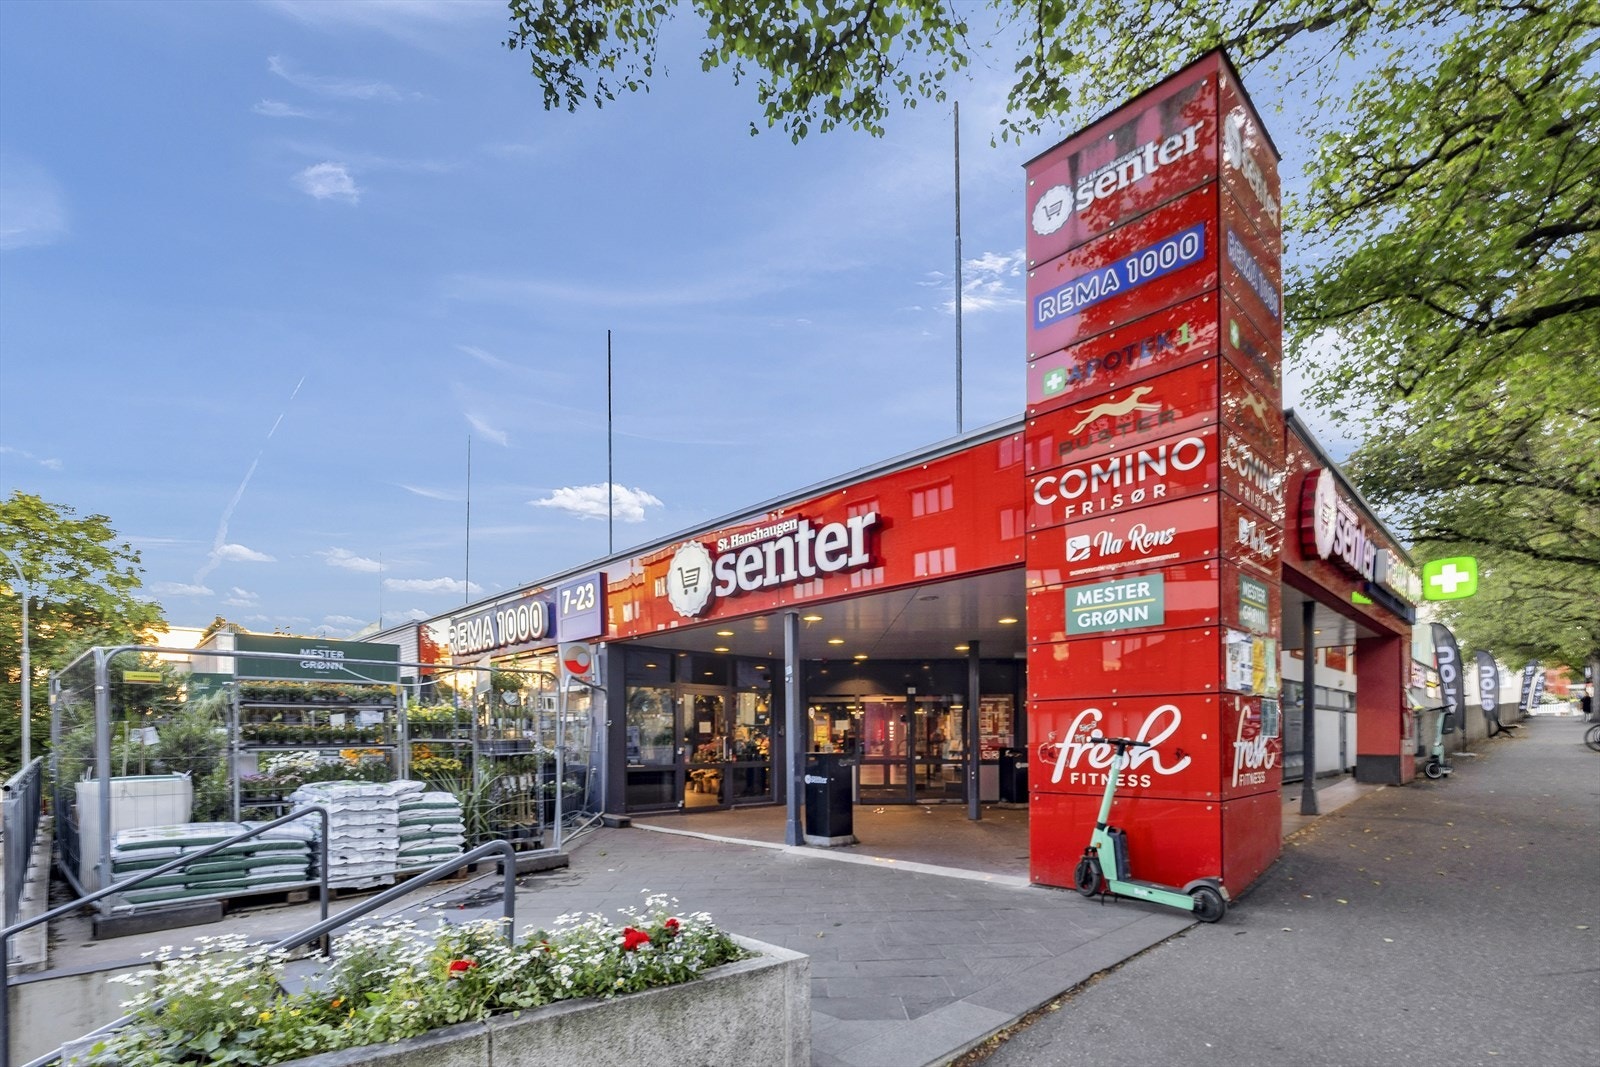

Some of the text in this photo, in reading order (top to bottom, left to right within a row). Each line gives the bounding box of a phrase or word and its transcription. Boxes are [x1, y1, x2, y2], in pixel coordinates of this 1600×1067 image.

[1076, 120, 1203, 211] senter
[1038, 232, 1199, 323] REMA 1000
[1065, 321, 1192, 385] APOTEK 1
[1058, 408, 1177, 456] BUSTER
[1033, 437, 1206, 506] COMINO
[1065, 483, 1166, 519] FRISØR
[717, 518, 798, 552] St. Hanshaugen
[1128, 523, 1176, 555] Rens
[715, 511, 877, 598] senter
[562, 582, 595, 615] 7-23
[1076, 581, 1150, 607] MESTER
[449, 601, 544, 656] REMA 1000
[1077, 605, 1149, 628] GRØNN
[300, 648, 345, 659] MESTER
[300, 660, 344, 670] GRØNN
